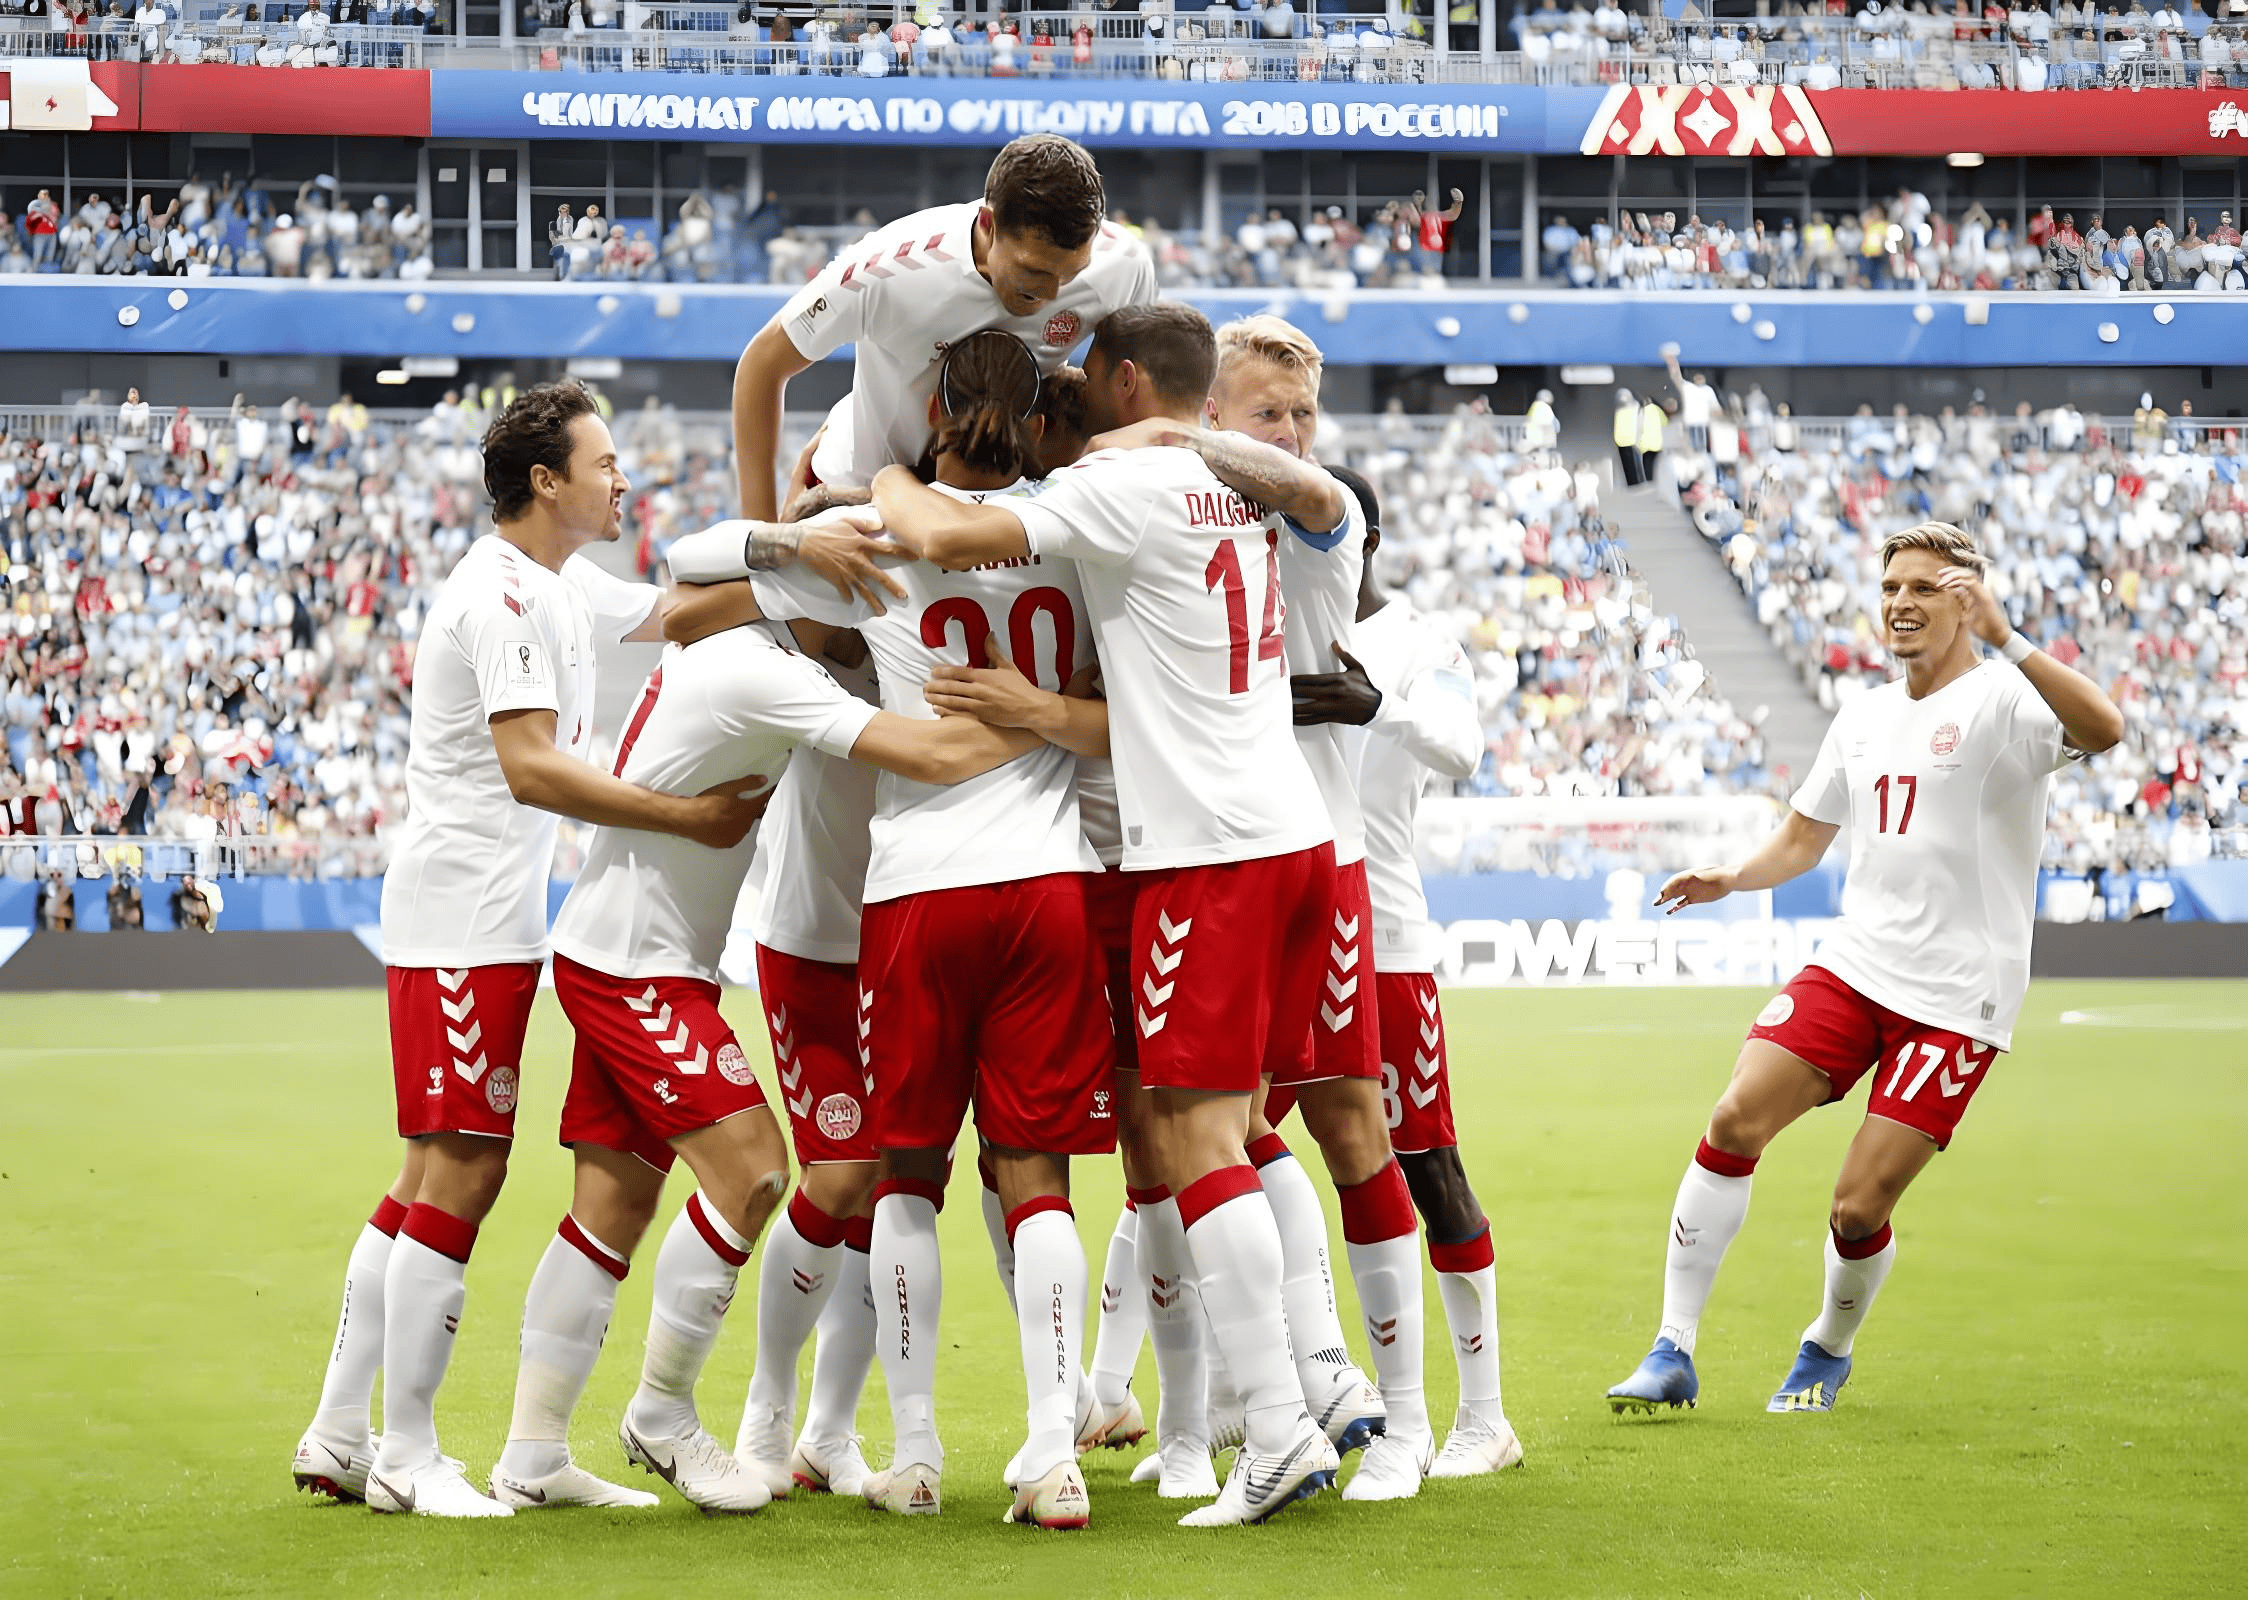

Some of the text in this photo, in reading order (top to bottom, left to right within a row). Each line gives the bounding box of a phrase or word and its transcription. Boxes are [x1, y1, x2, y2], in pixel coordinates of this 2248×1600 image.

[886, 97, 944, 133] ПО
[1204, 528, 1286, 694] 14
[1873, 774, 1917, 835] 17
[1428, 918, 1842, 986] OWERA
[1884, 1041, 1946, 1102] 17
[895, 1264, 909, 1361] DANMARK
[1052, 1282, 1066, 1384] DANMARK
